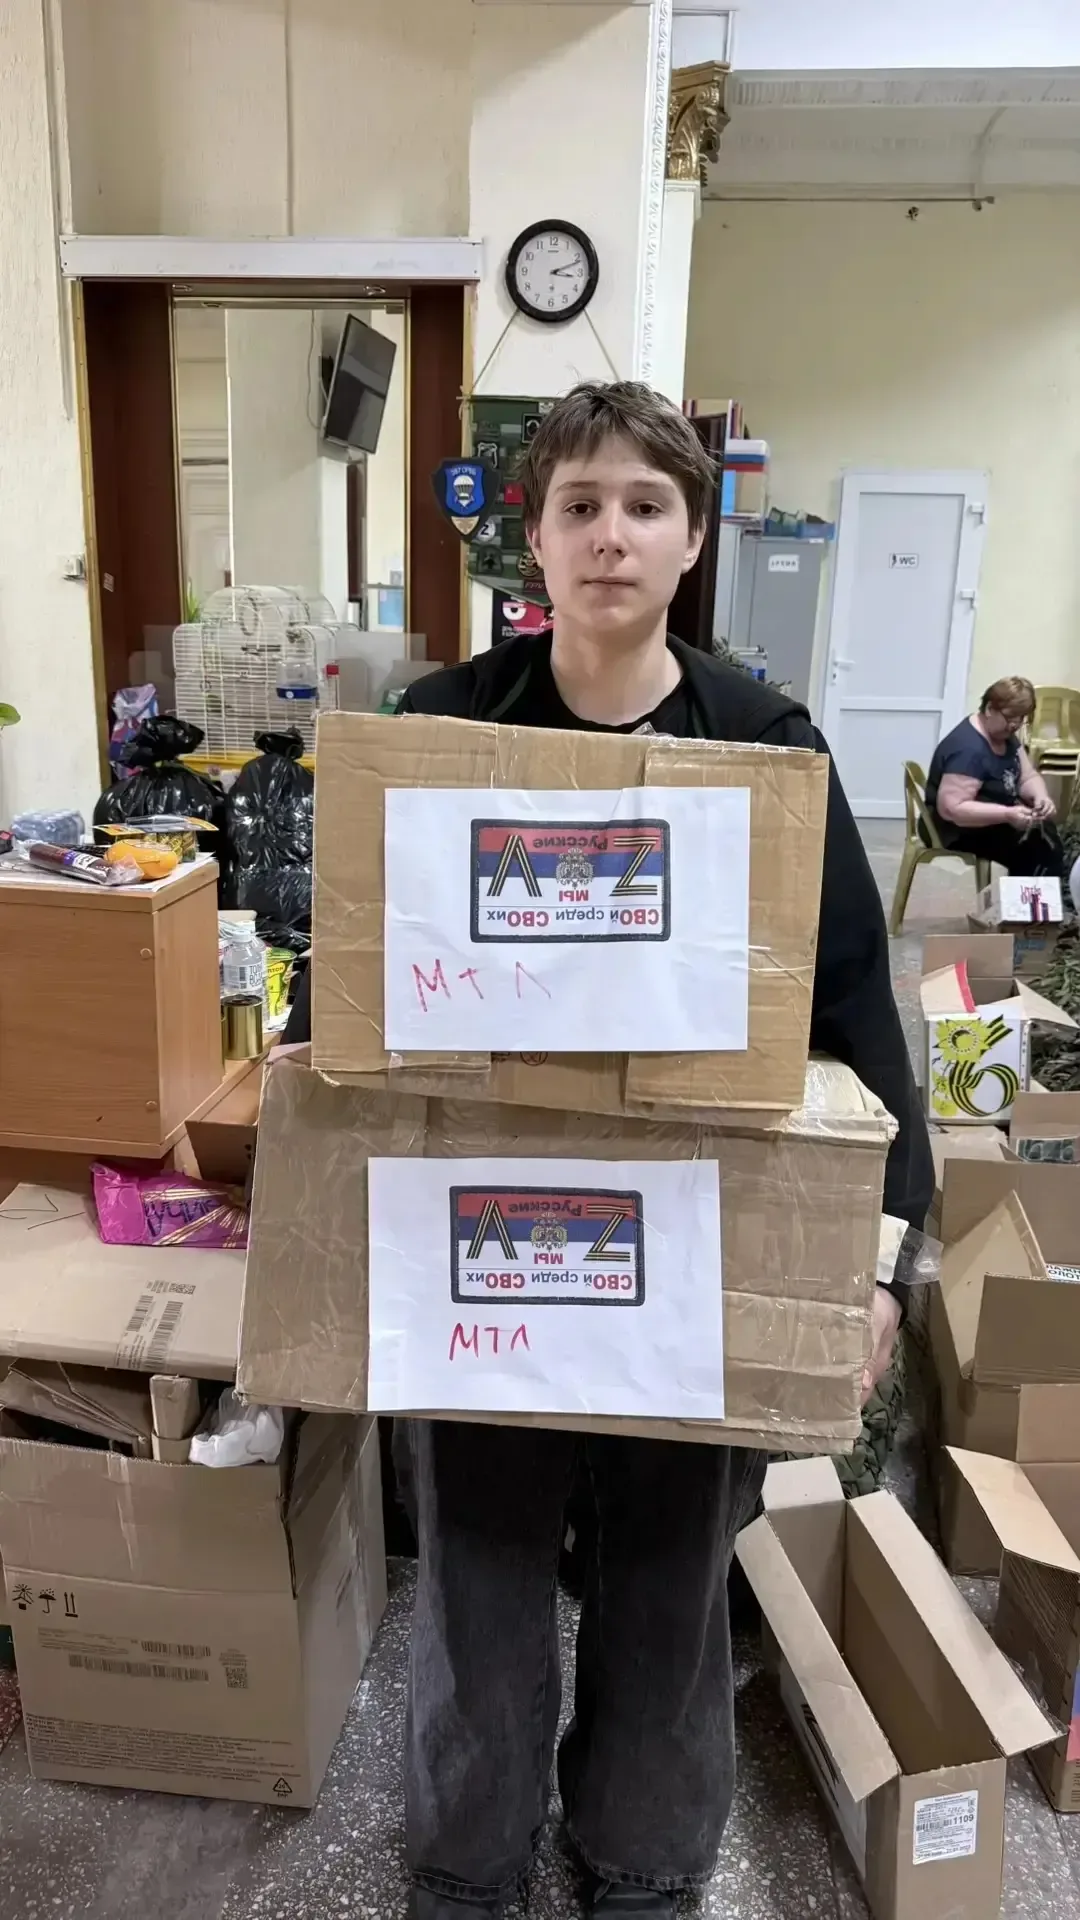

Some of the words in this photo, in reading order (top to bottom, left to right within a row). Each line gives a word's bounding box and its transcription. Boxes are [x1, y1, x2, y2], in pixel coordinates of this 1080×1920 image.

[536, 241, 544, 249] 11
[550, 237, 558, 246] 12
[566, 241, 570, 249] 1
[526, 252, 534, 260] 10
[574, 253, 580, 261] 2
[521, 267, 528, 276] 9
[577, 269, 583, 277] 3
[525, 282, 531, 290] 8
[573, 284, 578, 292] 4
[535, 294, 540, 302] 7
[548, 298, 554, 307] 6
[562, 295, 568, 303] 5
[481, 524, 490, 535] Z
[899, 556, 915, 564] WC
[533, 835, 608, 850] Русские
[610, 836, 659, 896] Z
[556, 907, 604, 920] среди
[610, 908, 659, 925] СВОй
[487, 910, 549, 927] СВОих
[508, 1200, 582, 1216] Русские
[583, 1203, 632, 1261] Z
[531, 1270, 578, 1283] среди
[1048, 1270, 1080, 1280] ОЛОТ
[466, 1272, 525, 1288] СВОих
[583, 1272, 632, 1290] СВОй
[954, 1814, 974, 1824] 1109
